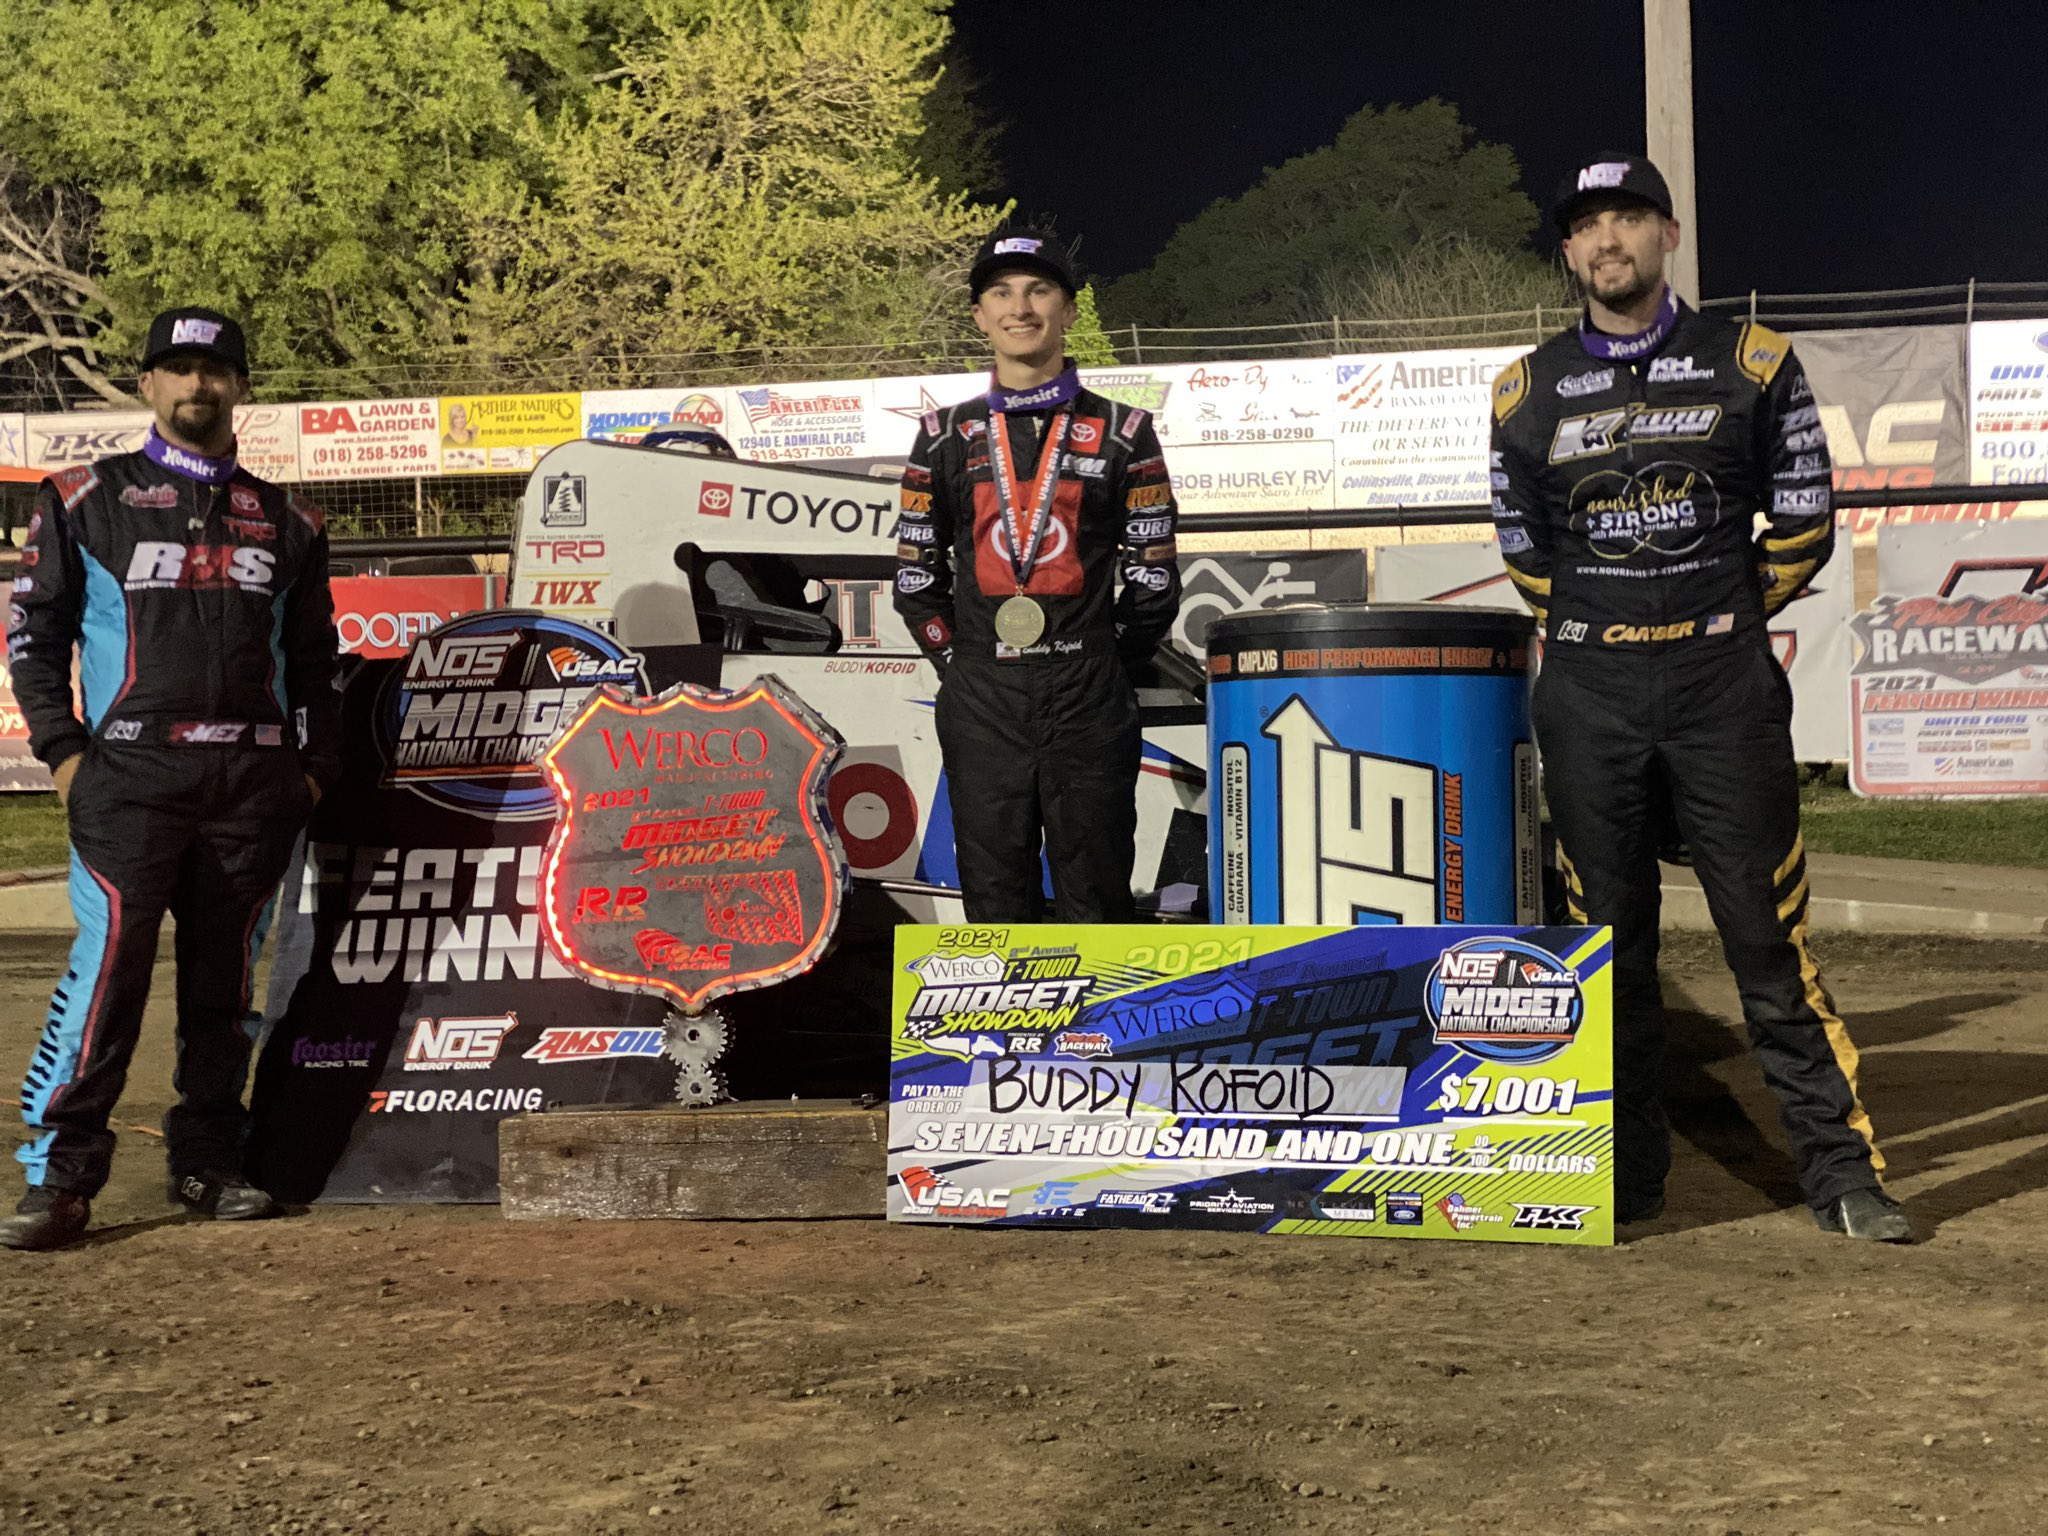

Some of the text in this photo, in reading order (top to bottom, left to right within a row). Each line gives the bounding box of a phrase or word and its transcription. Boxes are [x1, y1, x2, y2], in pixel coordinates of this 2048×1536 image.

[359, 402, 431, 417] LAWN &
[471, 399, 518, 419] MOTHER
[523, 413, 546, 422] LAWN
[301, 407, 359, 434] BA
[359, 418, 436, 433] GARDEN
[588, 411, 671, 428] MOMO'S
[770, 414, 862, 427] HOSE & ACCESSORIES
[1340, 420, 1373, 433] THE
[738, 431, 866, 449] 12940 E. ADMIRAL PLACE
[1201, 427, 1314, 442] 918-258-0290
[1372, 438, 1407, 451] OUR
[161, 446, 217, 478] Hoosier
[313, 444, 428, 465] (918) 258-5296
[750, 446, 854, 461] 918-437-7002
[1341, 455, 1396, 467] Committed
[1411, 454, 1426, 464] the
[307, 468, 341, 478] SALES
[350, 465, 393, 475] SERVICE
[402, 463, 438, 473] PARTS
[1038, 447, 1061, 501] USAC 2021
[1172, 469, 1333, 489] BOB HURLEY RV
[1000, 476, 1012, 500] 2021
[1342, 473, 1414, 489] Collinsville,
[1205, 489, 1258, 500] Adventure
[1421, 492, 1432, 503] &
[1006, 507, 1018, 536] USAC
[1029, 508, 1043, 532] 2021
[1600, 500, 1695, 530] STRONG
[1126, 519, 1172, 536] CURB
[525, 540, 606, 564] TRD
[530, 580, 602, 605] IWX
[405, 628, 525, 679] NOS
[1282, 649, 1320, 671] HIGH
[1320, 647, 1440, 669] PERFORMANCE
[1440, 647, 1494, 668] ENERGY
[561, 658, 638, 678] USAC
[402, 677, 496, 690] ENERGY DRINK
[1864, 675, 1937, 691] 2021
[1863, 692, 1976, 712] FEATURE
[397, 740, 478, 767] NATIONAL
[598, 727, 769, 772] WERCO
[1226, 759, 1234, 817] INOSITOL
[583, 787, 650, 812] 2021
[703, 789, 766, 812] T-TOWN
[622, 808, 779, 850] MIDGET
[1235, 759, 1244, 914] GUARANA VITAMIN B12
[631, 832, 787, 874] SHOWDOWN
[1442, 768, 1464, 923] ENERGY DRINK
[576, 886, 648, 918] RR
[937, 928, 1009, 949] 2021
[650, 944, 733, 965] USAC
[1009, 943, 1078, 959] 2nd Annual
[1126, 936, 1254, 974] 2021
[930, 959, 1000, 979] WERCO
[1003, 957, 1078, 982] T-TOWN
[1440, 950, 1507, 979] NOS
[1470, 978, 1494, 986] DRINK
[1530, 972, 1576, 983] USAC
[909, 979, 1091, 1016] MIDGET
[1441, 987, 1576, 1016] MIDGET
[928, 1004, 1080, 1039] SHOWDOWN
[1110, 996, 1243, 1040] WERCO
[1439, 1016, 1570, 1033] NATIONAL CHAMPIONSHIP
[404, 1011, 519, 1063] NOS
[536, 1029, 666, 1058] AMSOIL
[1008, 1037, 1042, 1052] RR
[1059, 1041, 1108, 1053] RACEWAY
[304, 1059, 369, 1068] RACING TIRE
[403, 1060, 492, 1073] ENERGY DRINK
[902, 1085, 964, 1098] PAY TO THE
[988, 1056, 1334, 1120] BUDDY KOFOID
[1438, 1073, 1579, 1116] $7,001
[906, 1101, 961, 1114] ORDER OF
[914, 1120, 1457, 1165] SEVEN THOUSAND AND ONE
[1474, 1135, 1490, 1149] 00
[1470, 1154, 1491, 1168] 100
[1508, 1154, 1597, 1175] DOLLARS
[918, 1186, 1011, 1208] USAC
[1190, 1200, 1275, 1210] PRIORITY AVIATION
[901, 1207, 935, 1215] 2021
[1333, 1209, 1373, 1218] METAL
[1446, 1205, 1482, 1214] Dahmer
[1451, 1213, 1504, 1223] Powertrain
[1456, 1221, 1474, 1230] Inc.
